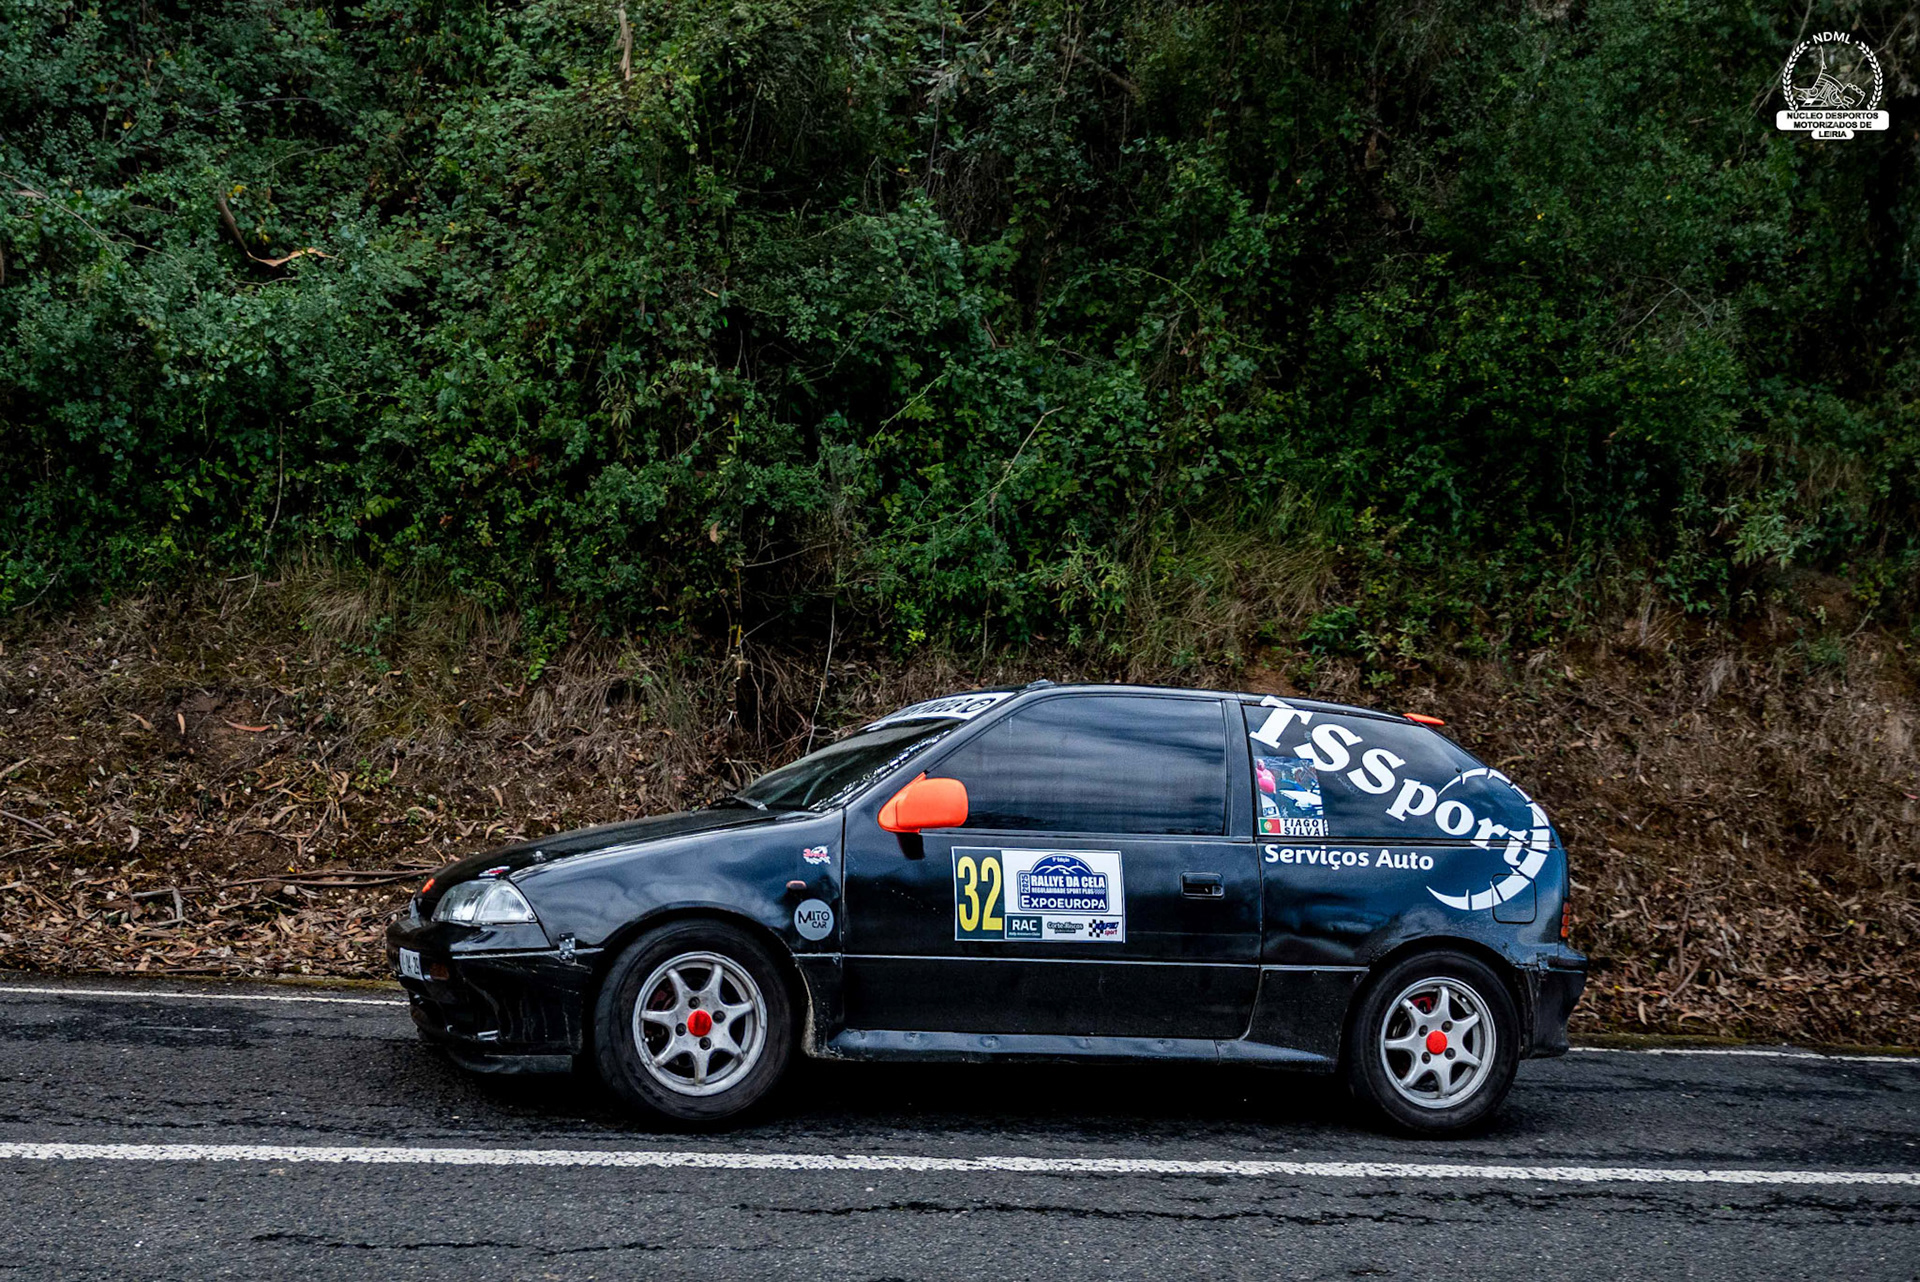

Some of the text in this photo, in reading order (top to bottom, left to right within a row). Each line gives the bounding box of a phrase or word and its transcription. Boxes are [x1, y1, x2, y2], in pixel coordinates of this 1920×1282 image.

[1283, 819, 1319, 827] TIAGO
[1284, 827, 1320, 836] SILVA
[1264, 844, 1434, 870] Serviços Auto
[1021, 874, 1030, 893] 2025
[1031, 875, 1105, 888] RALLYE DA CELA
[957, 856, 1003, 932] 32
[1012, 919, 1037, 931] RAC
